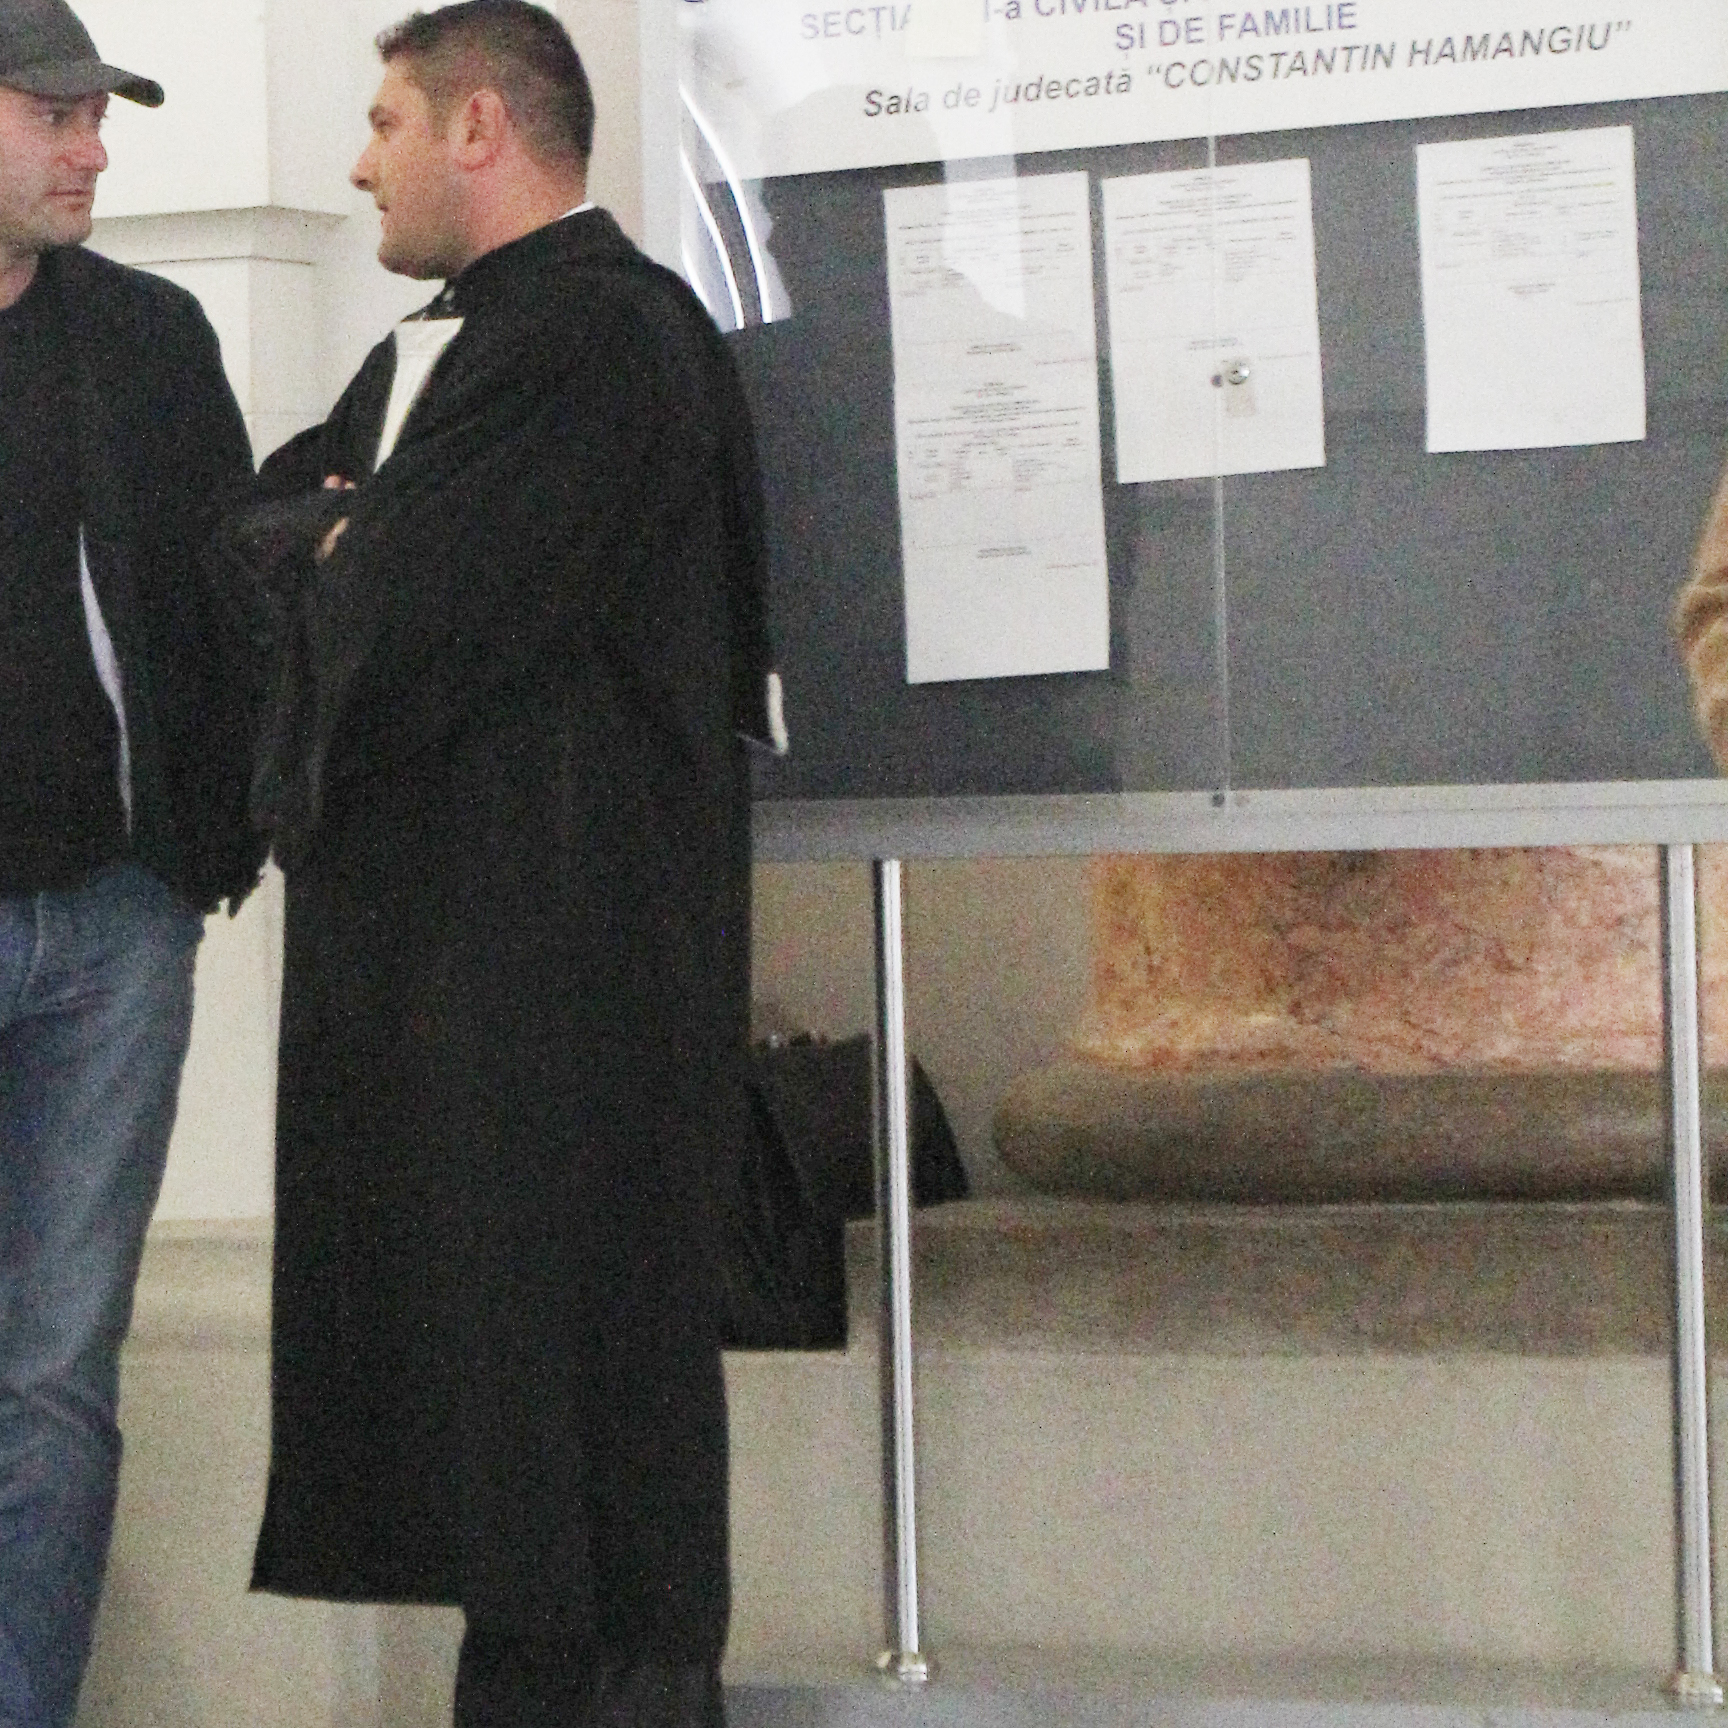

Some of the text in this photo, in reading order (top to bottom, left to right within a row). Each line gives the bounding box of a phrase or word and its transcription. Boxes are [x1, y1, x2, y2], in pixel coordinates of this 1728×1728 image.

[1158, 15, 1205, 47] DE
[1218, 1, 1358, 41] FAMILIE
[862, 86, 930, 118] Sala
[942, 81, 982, 110] de
[987, 68, 1134, 114] judecată
